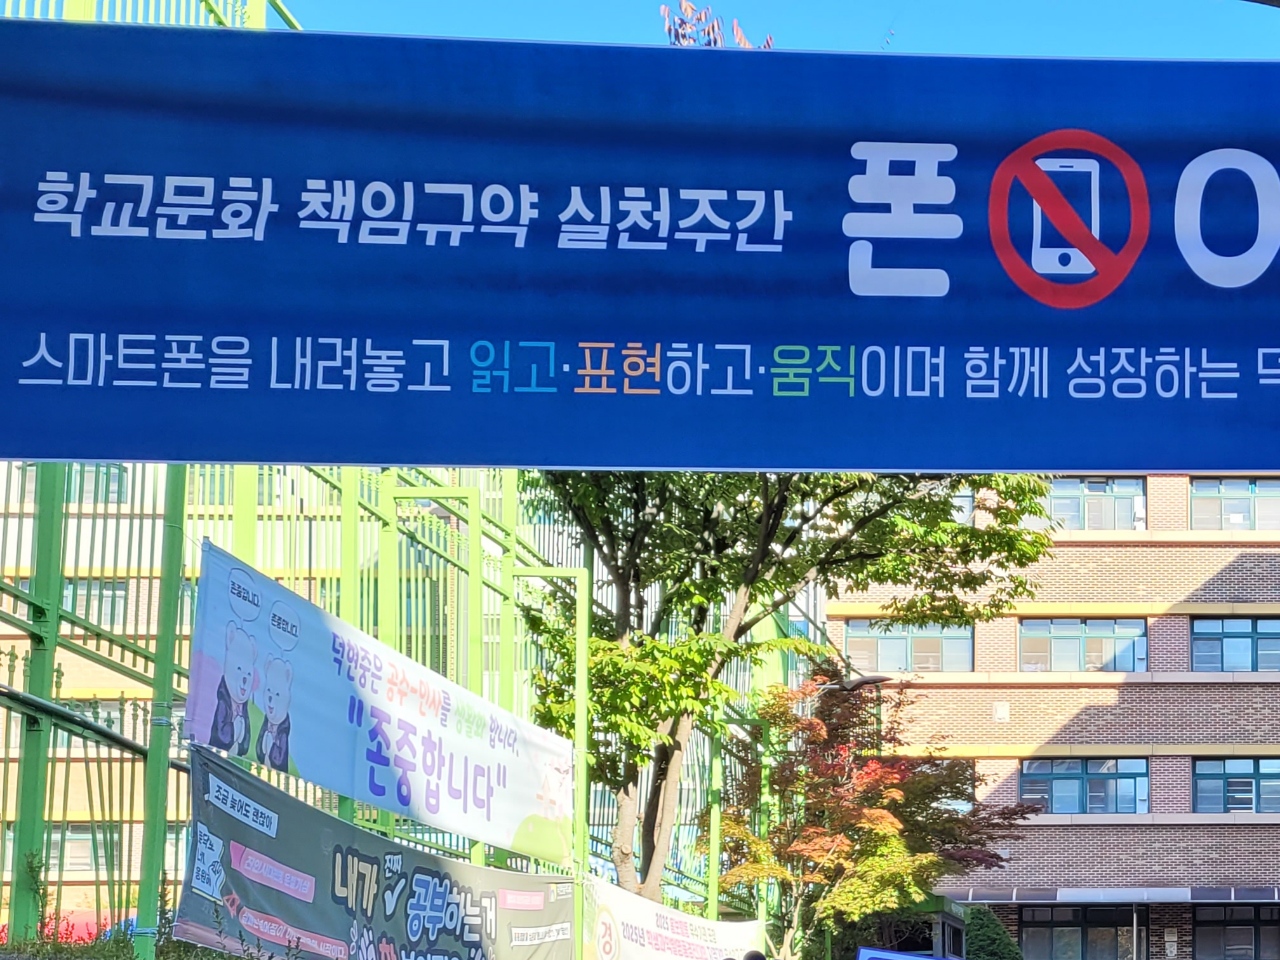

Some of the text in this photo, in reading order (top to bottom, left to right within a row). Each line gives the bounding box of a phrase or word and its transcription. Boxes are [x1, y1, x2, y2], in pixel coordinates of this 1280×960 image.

[33, 141, 965, 298] 학교문화 책임규약 실천주간 폰
[18, 332, 254, 390] 스마트폰을
[269, 336, 453, 393] 내려놓고
[963, 346, 1050, 399] 함께
[1066, 346, 1241, 399] 성장하는
[331, 631, 383, 695] 덕현중은
[214, 784, 274, 832] 조금 늦어도 괜찮아
[334, 852, 378, 918] 내가
